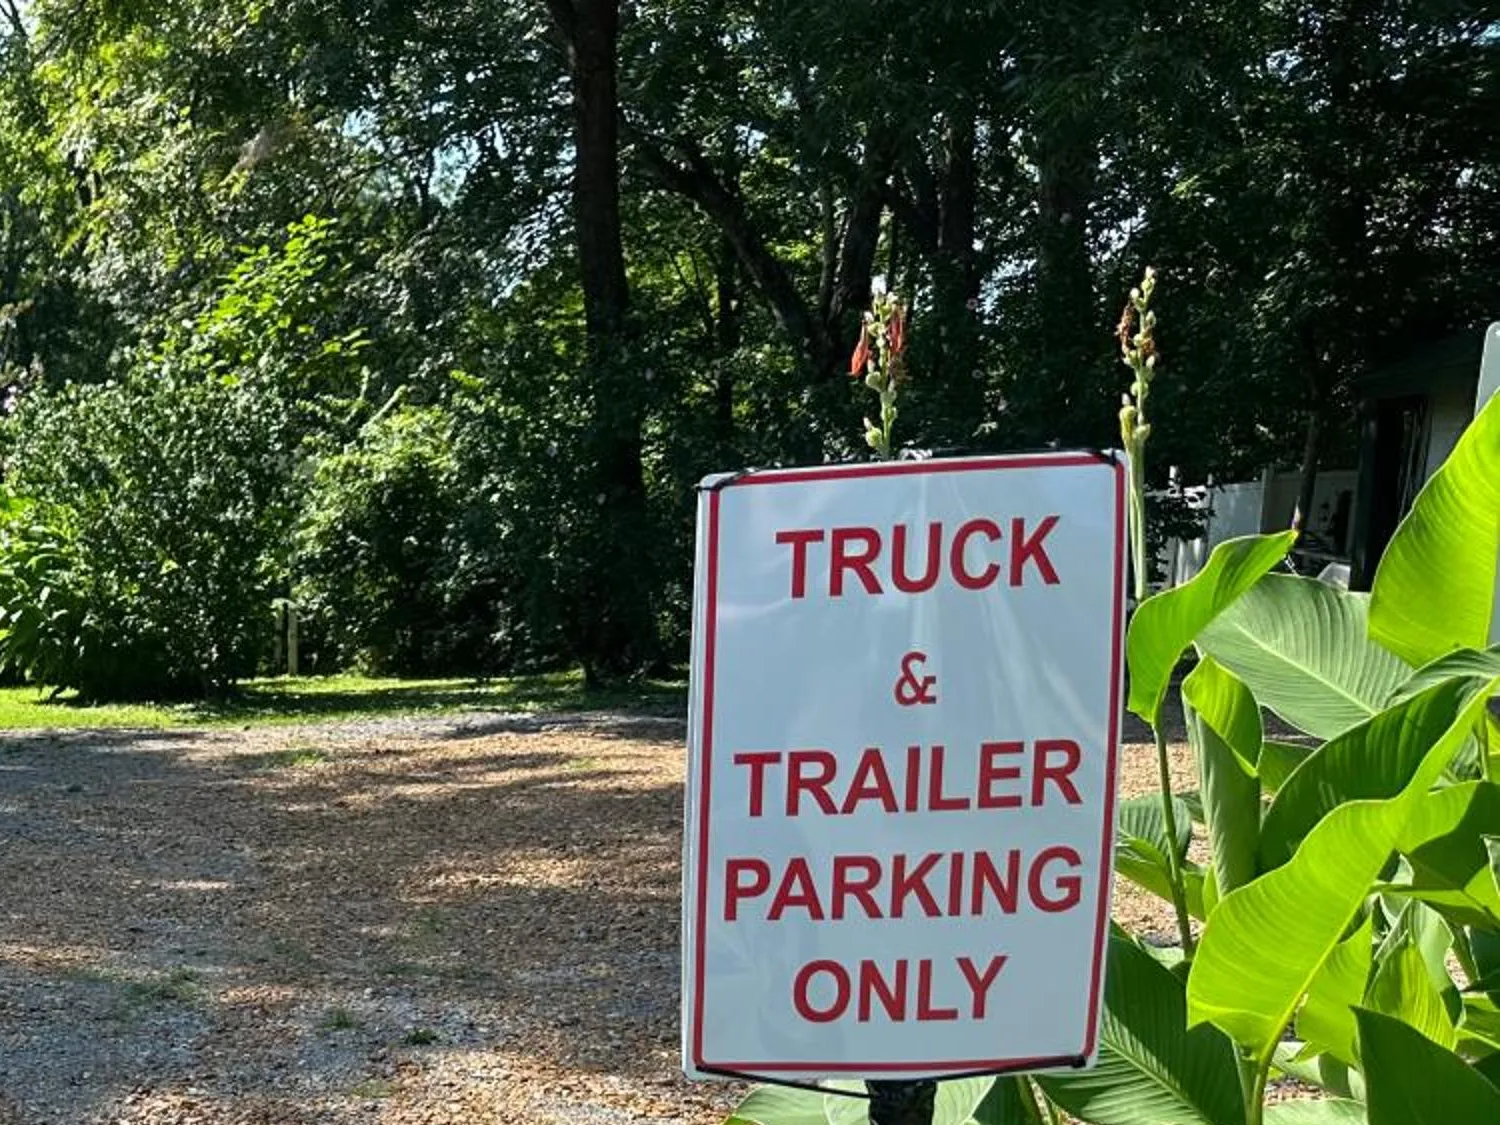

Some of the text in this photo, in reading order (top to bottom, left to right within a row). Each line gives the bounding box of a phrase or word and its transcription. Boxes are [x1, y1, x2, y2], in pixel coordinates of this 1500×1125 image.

[775, 515, 1061, 599] TRUCK
[894, 651, 938, 706] &
[734, 738, 1083, 818] TRAILER
[723, 846, 1083, 922] PARKING
[792, 955, 1008, 1024] ONLY
